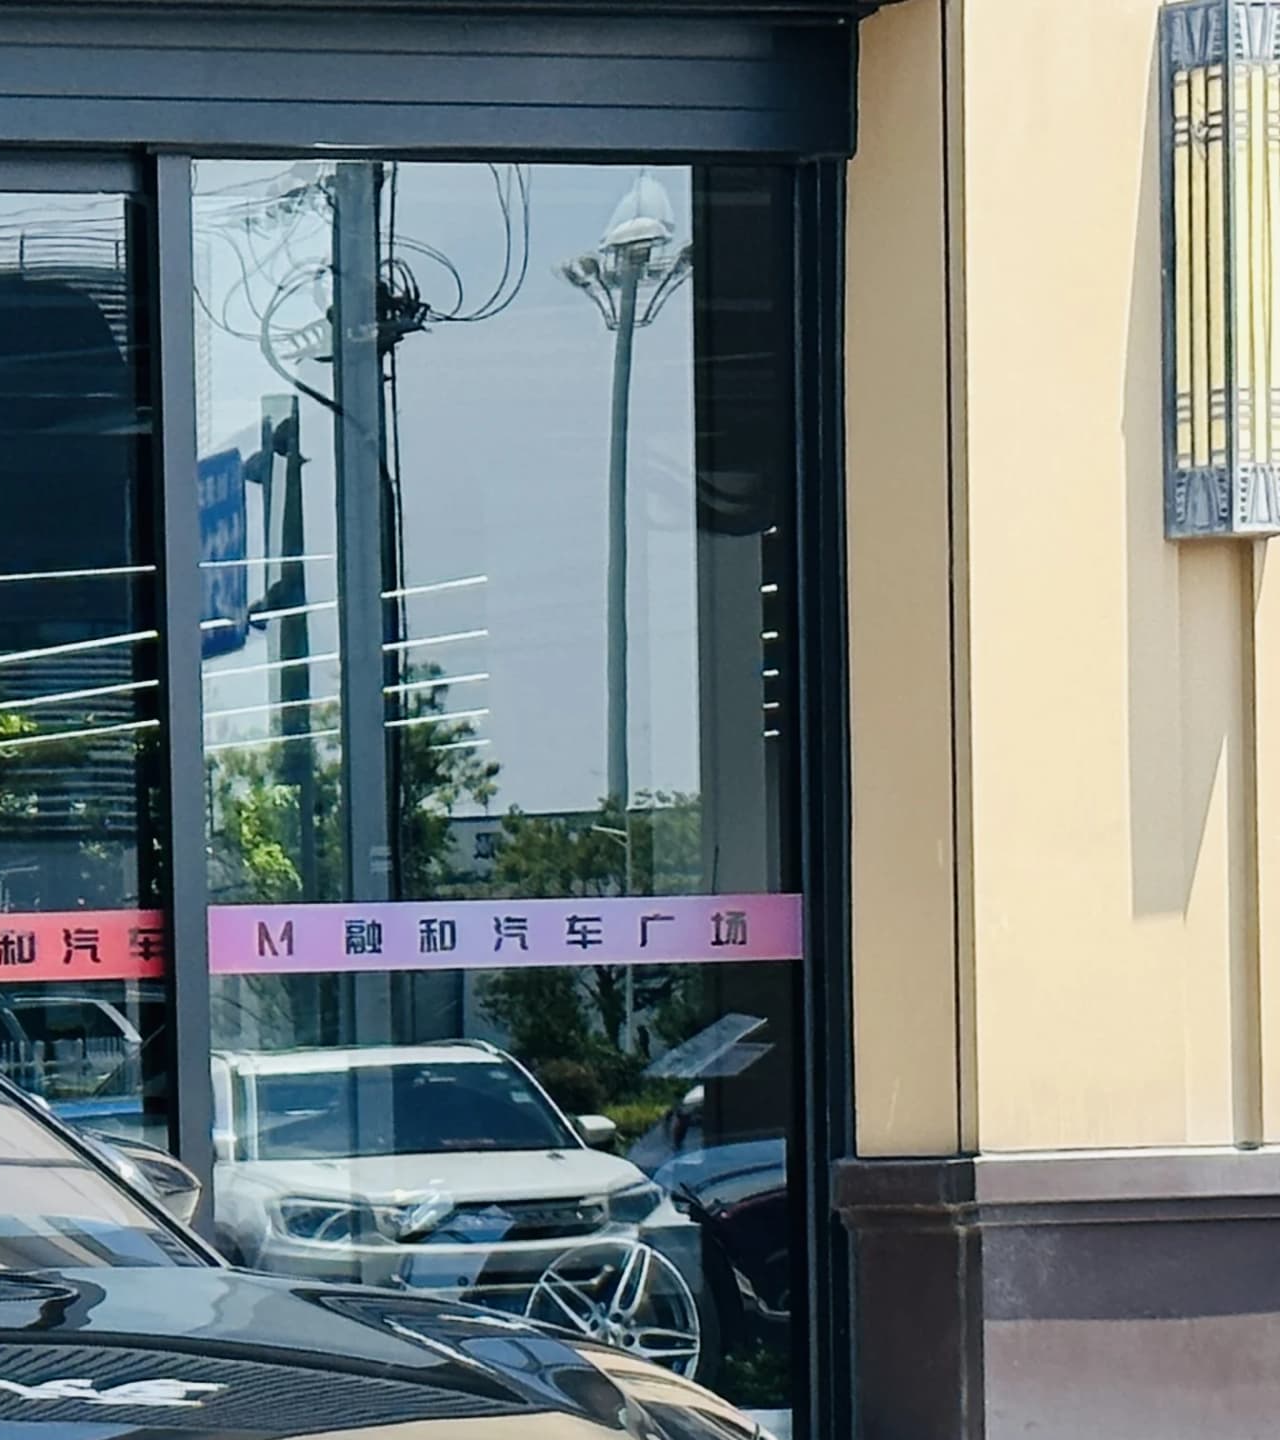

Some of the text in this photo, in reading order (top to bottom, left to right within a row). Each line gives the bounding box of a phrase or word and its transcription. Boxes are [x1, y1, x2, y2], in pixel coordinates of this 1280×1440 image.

[256, 910, 749, 957] M 融和汽车广场
